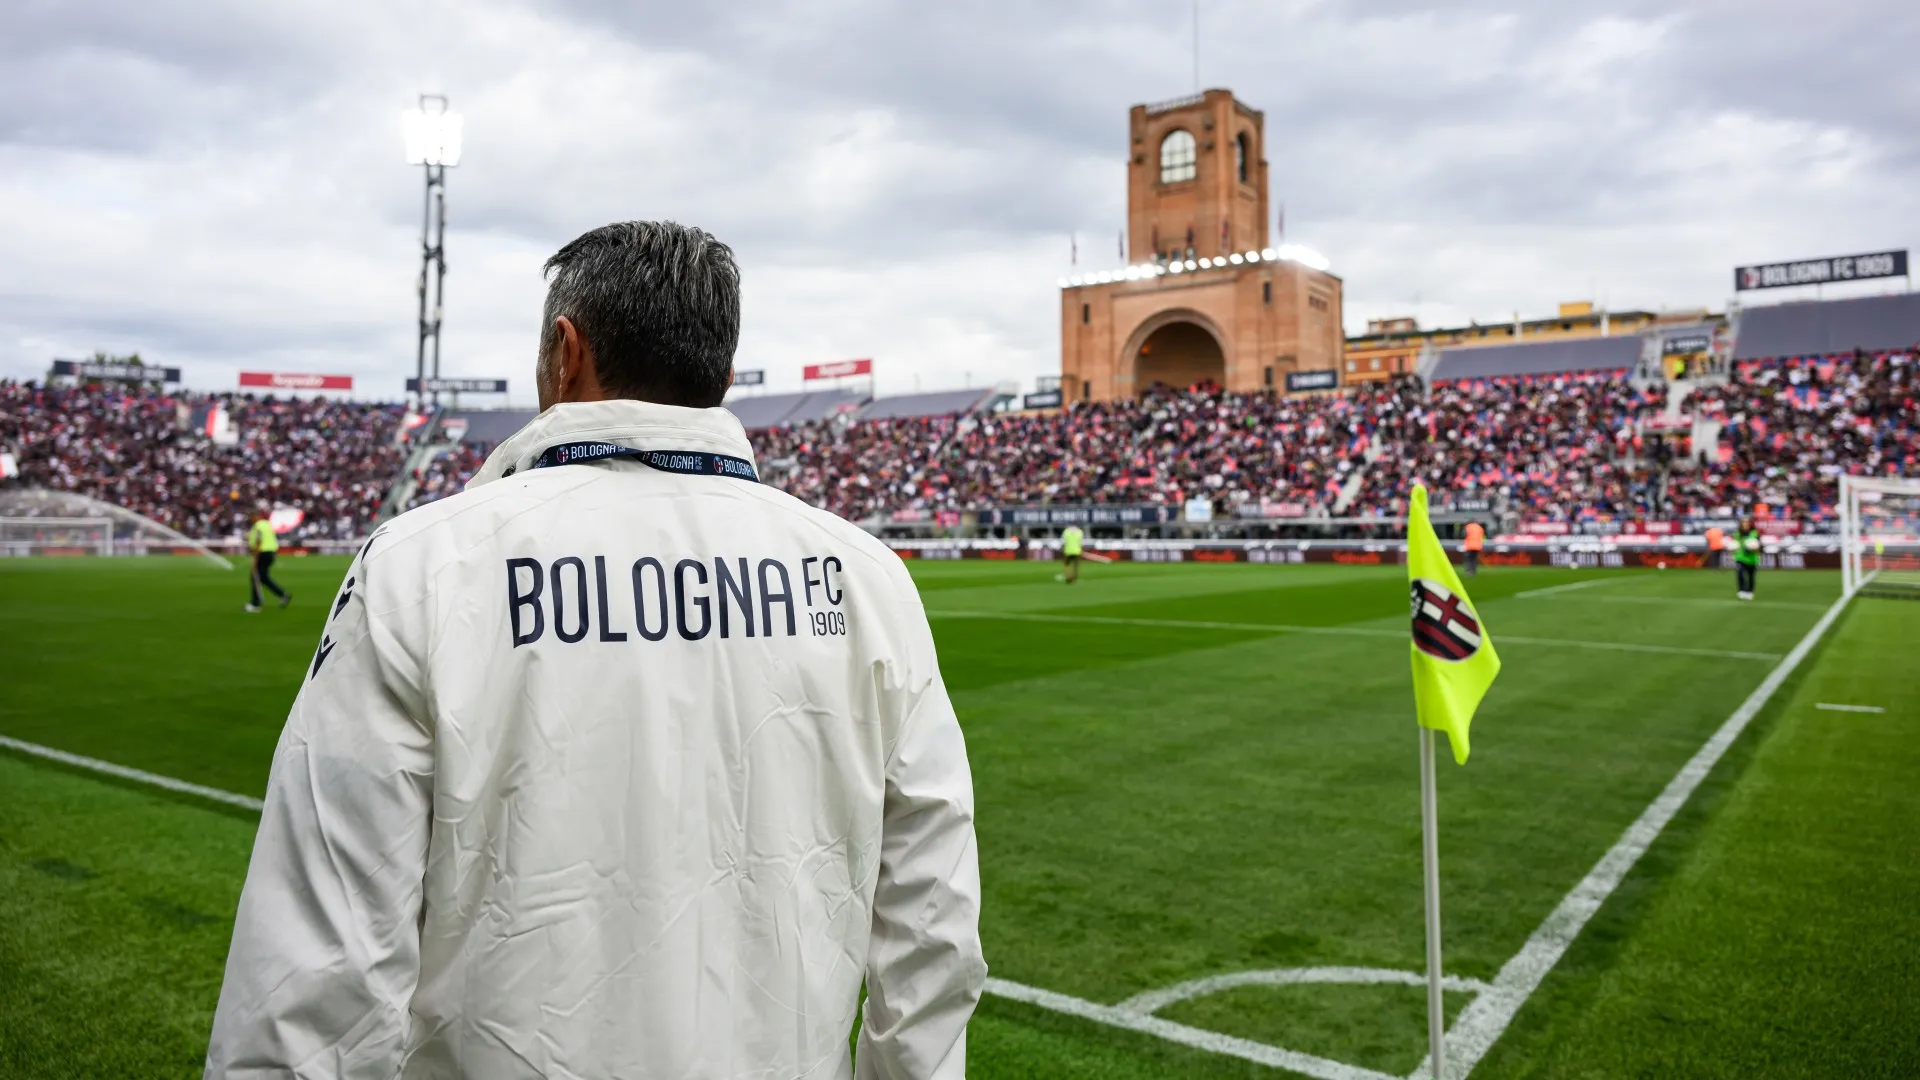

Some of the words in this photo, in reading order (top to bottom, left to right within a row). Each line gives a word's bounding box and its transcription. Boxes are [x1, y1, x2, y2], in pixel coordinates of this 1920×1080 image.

[1833, 257, 1853, 279] FC
[571, 445, 616, 459] BOLOGNA
[651, 452, 694, 470] BOLOGNA
[506, 555, 796, 648] BOLOGNA
[802, 556, 843, 606] FC
[809, 611, 846, 636] 1909
